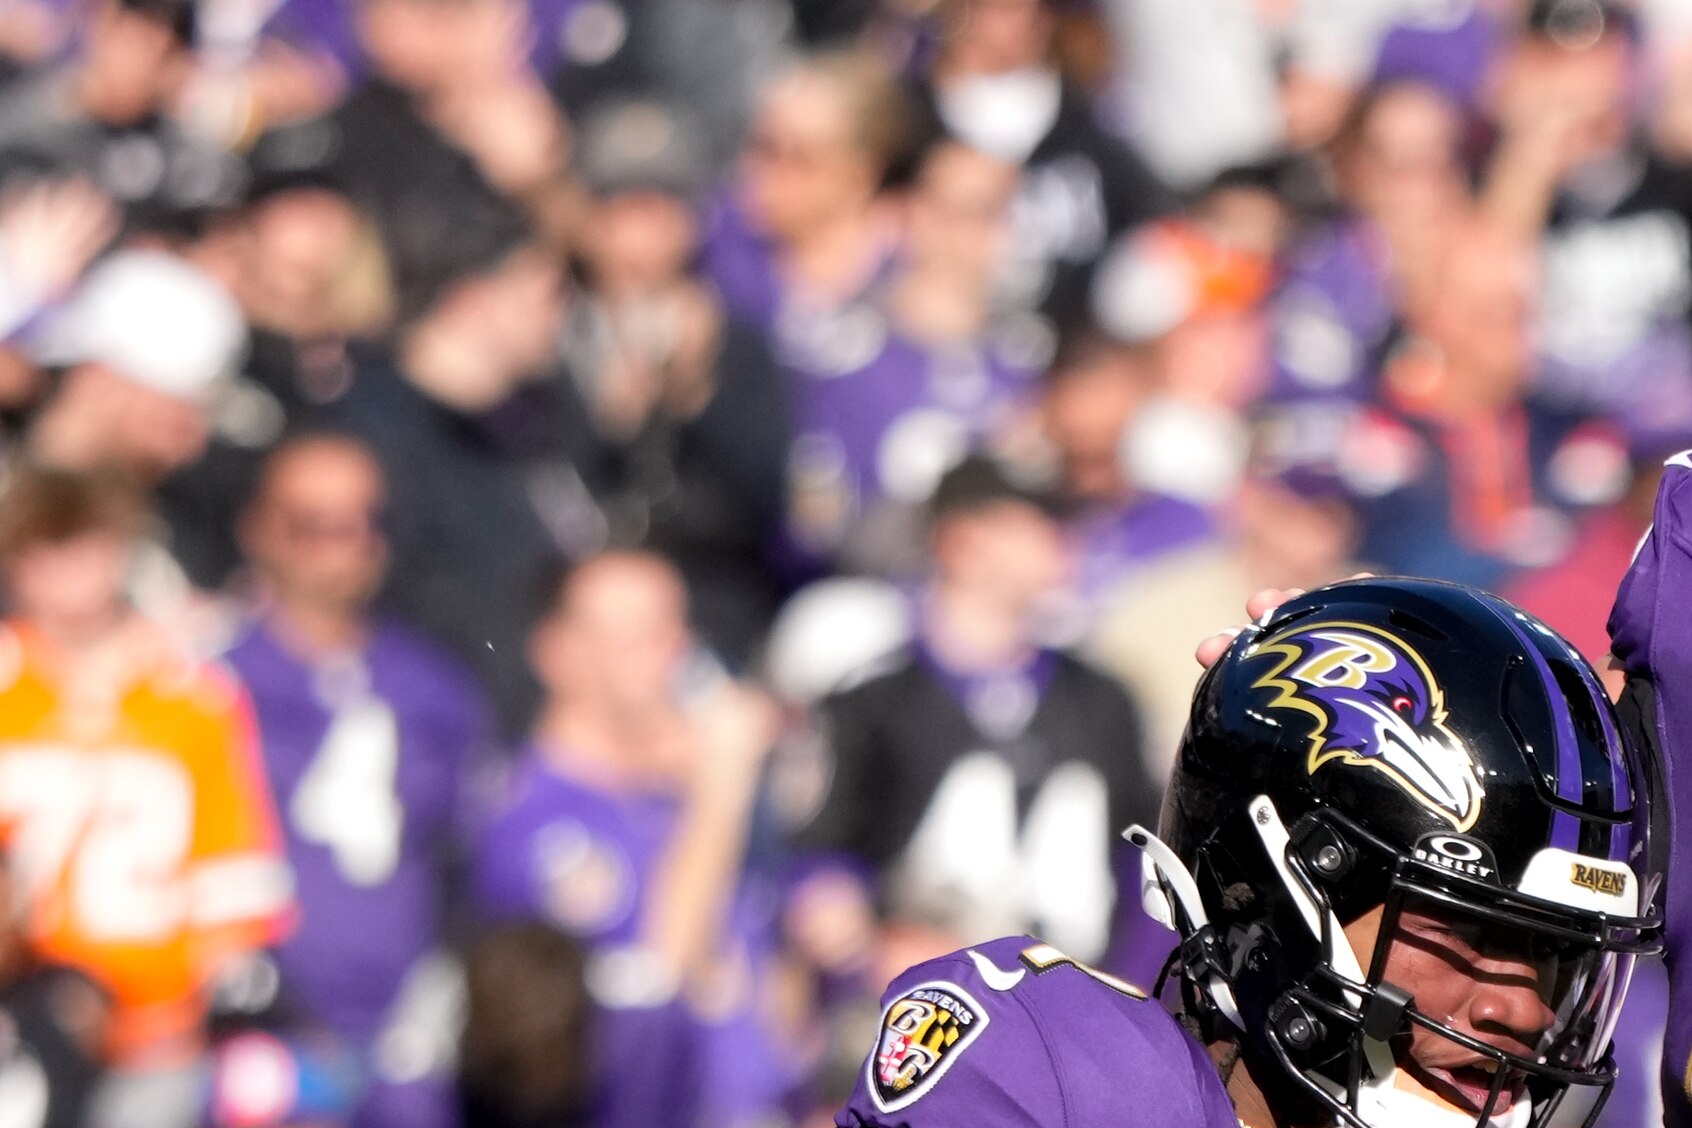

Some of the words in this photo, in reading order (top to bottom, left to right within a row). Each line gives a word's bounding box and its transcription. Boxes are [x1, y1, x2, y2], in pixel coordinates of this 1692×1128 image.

[1290, 632, 1397, 690] B
[1415, 848, 1494, 878] OAKLEY
[1570, 861, 1627, 897] RAVENS
